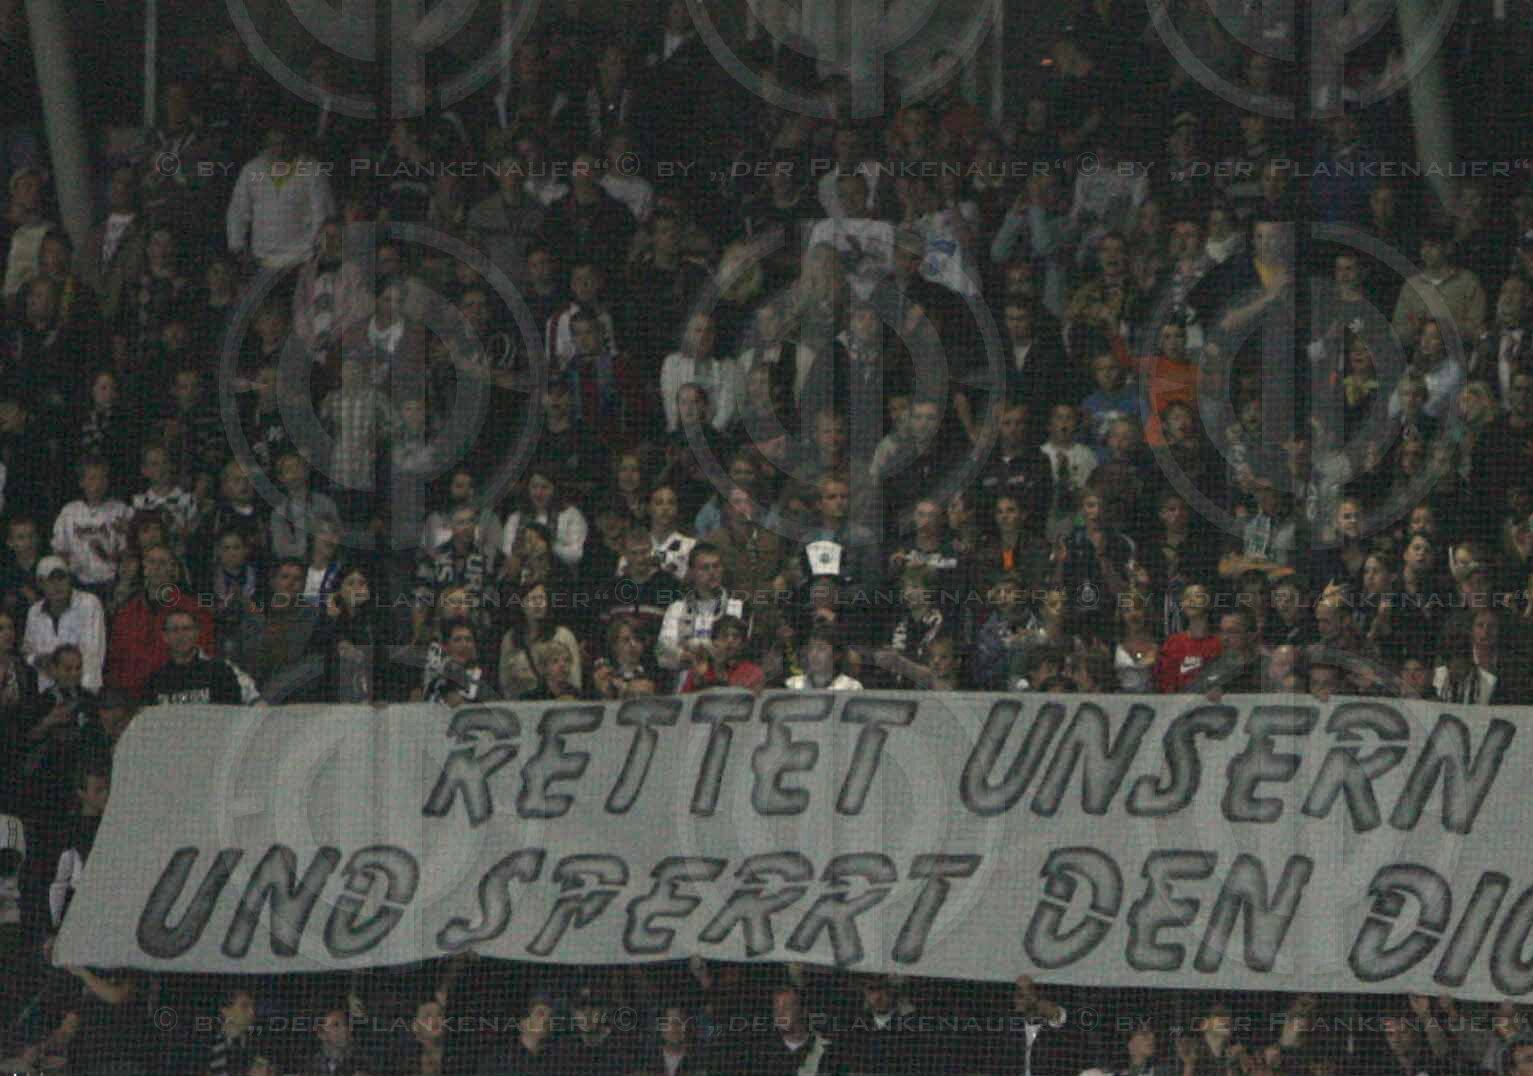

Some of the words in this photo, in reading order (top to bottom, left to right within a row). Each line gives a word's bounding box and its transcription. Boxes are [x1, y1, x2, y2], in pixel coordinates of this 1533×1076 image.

[424, 694, 918, 825] RETTET
[959, 699, 1517, 832] UNSERN
[136, 844, 420, 959] UND
[437, 848, 982, 966] SPERRT
[1024, 847, 1313, 972] DEN
